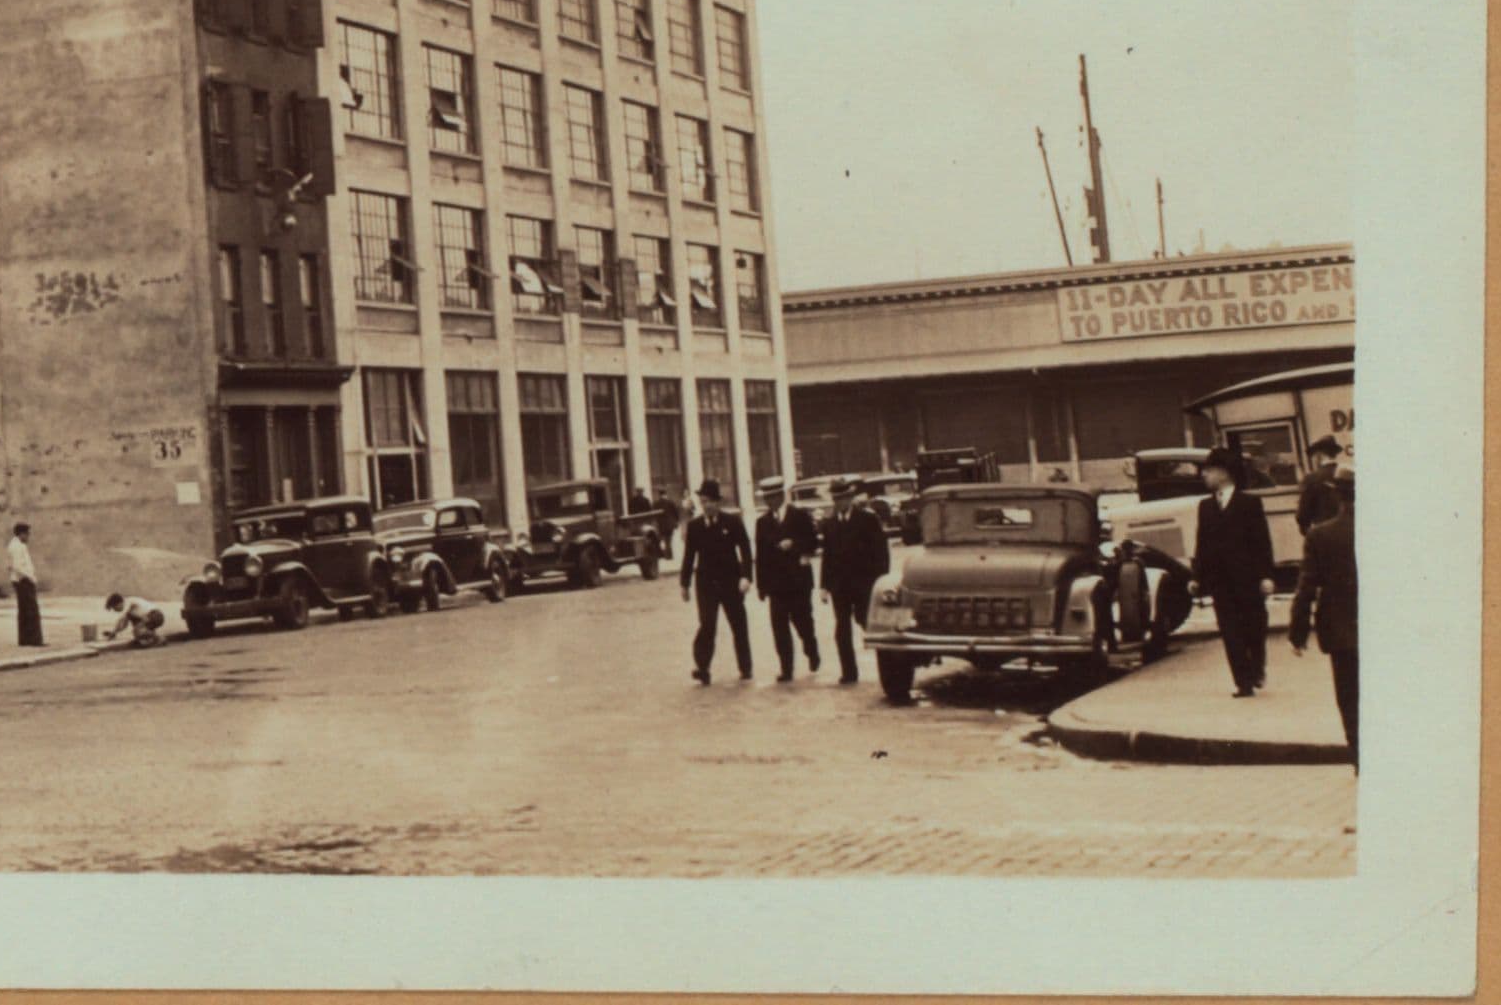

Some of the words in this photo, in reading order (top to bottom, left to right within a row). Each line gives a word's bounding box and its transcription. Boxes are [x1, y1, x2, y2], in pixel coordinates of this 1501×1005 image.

[1066, 280, 1168, 312] 11-DAY
[1179, 276, 1237, 301] ALL
[1069, 313, 1103, 338] TO
[1111, 304, 1213, 335] PUERTO
[1223, 300, 1288, 326] RICO
[1295, 302, 1341, 321] AND
